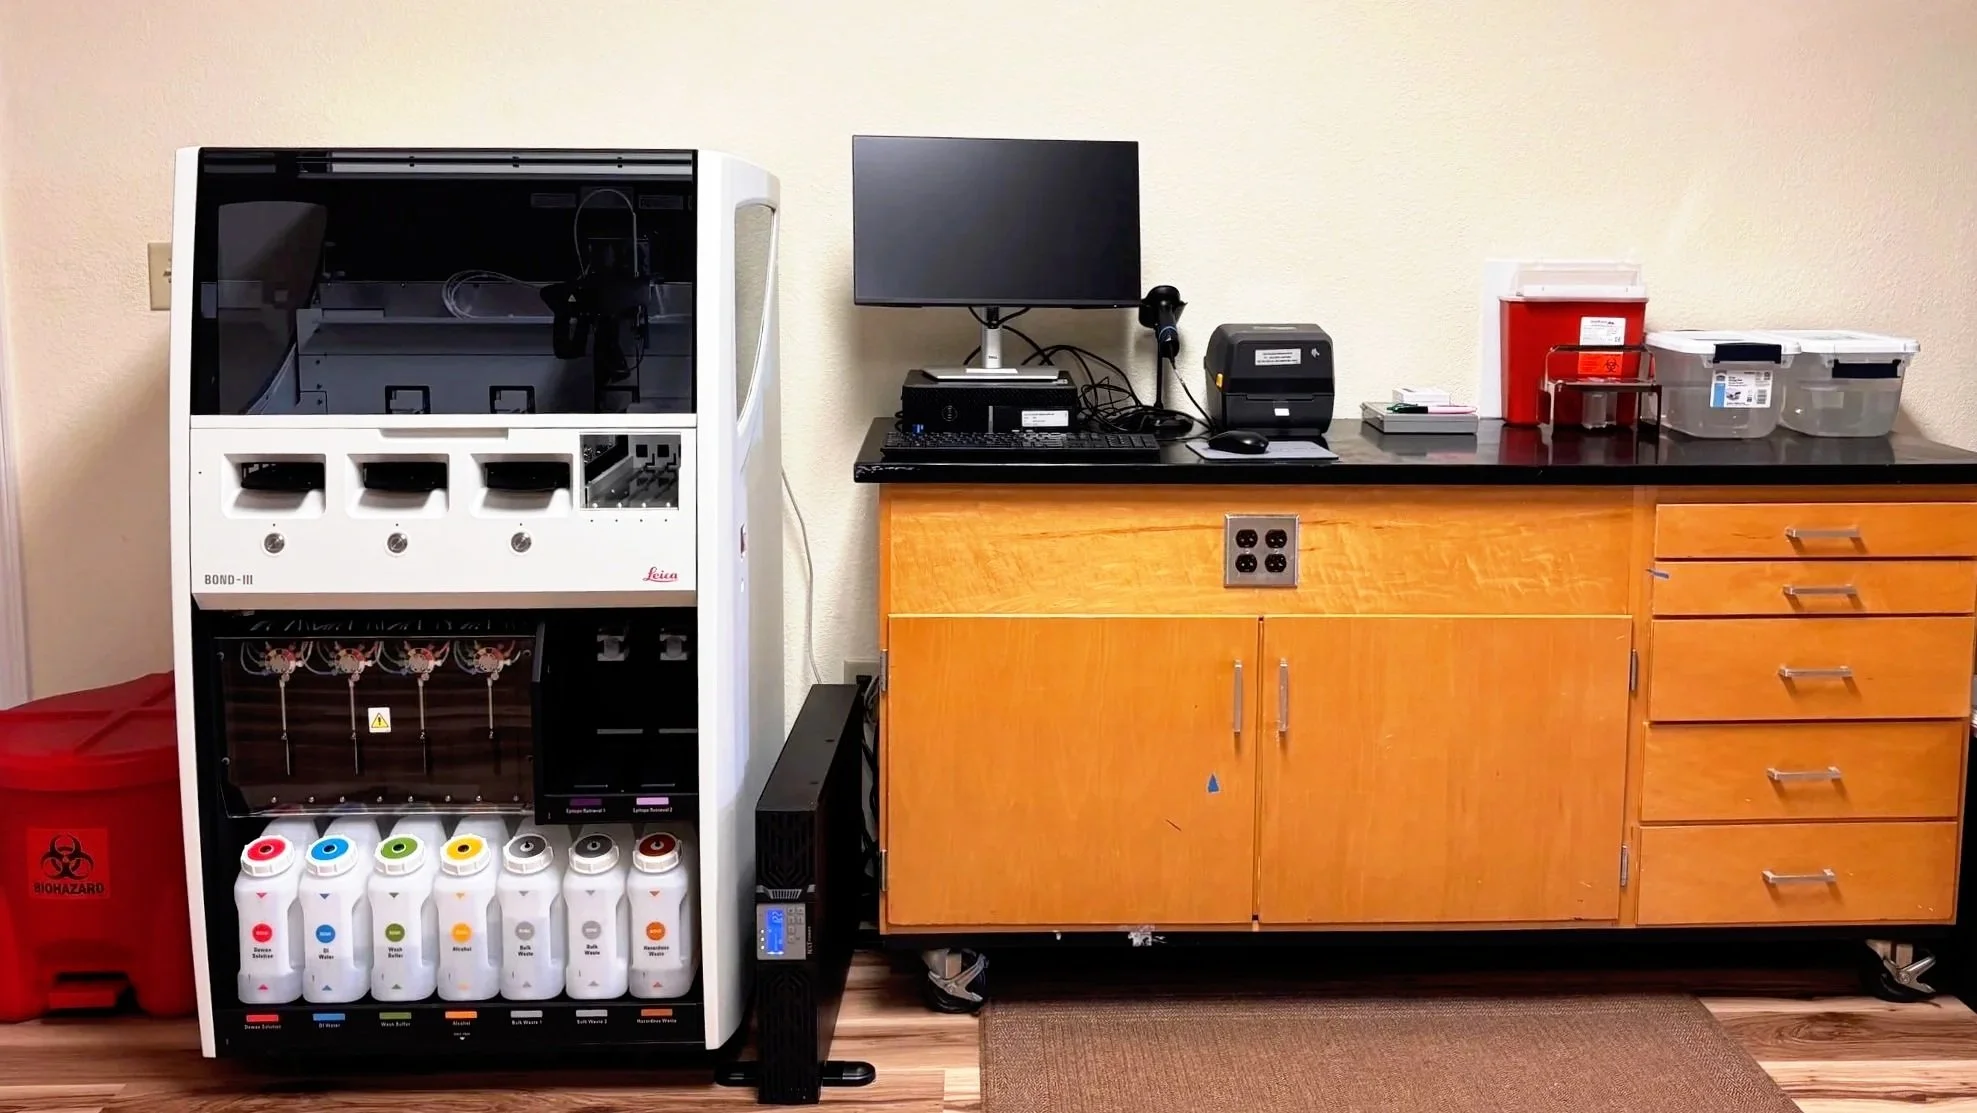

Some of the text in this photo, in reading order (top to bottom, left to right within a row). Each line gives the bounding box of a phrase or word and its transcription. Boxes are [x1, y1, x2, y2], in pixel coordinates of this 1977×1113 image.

[204, 574, 253, 585] BOND-III
[642, 566, 679, 583] Leica
[34, 882, 105, 895] BIOHAZARD
